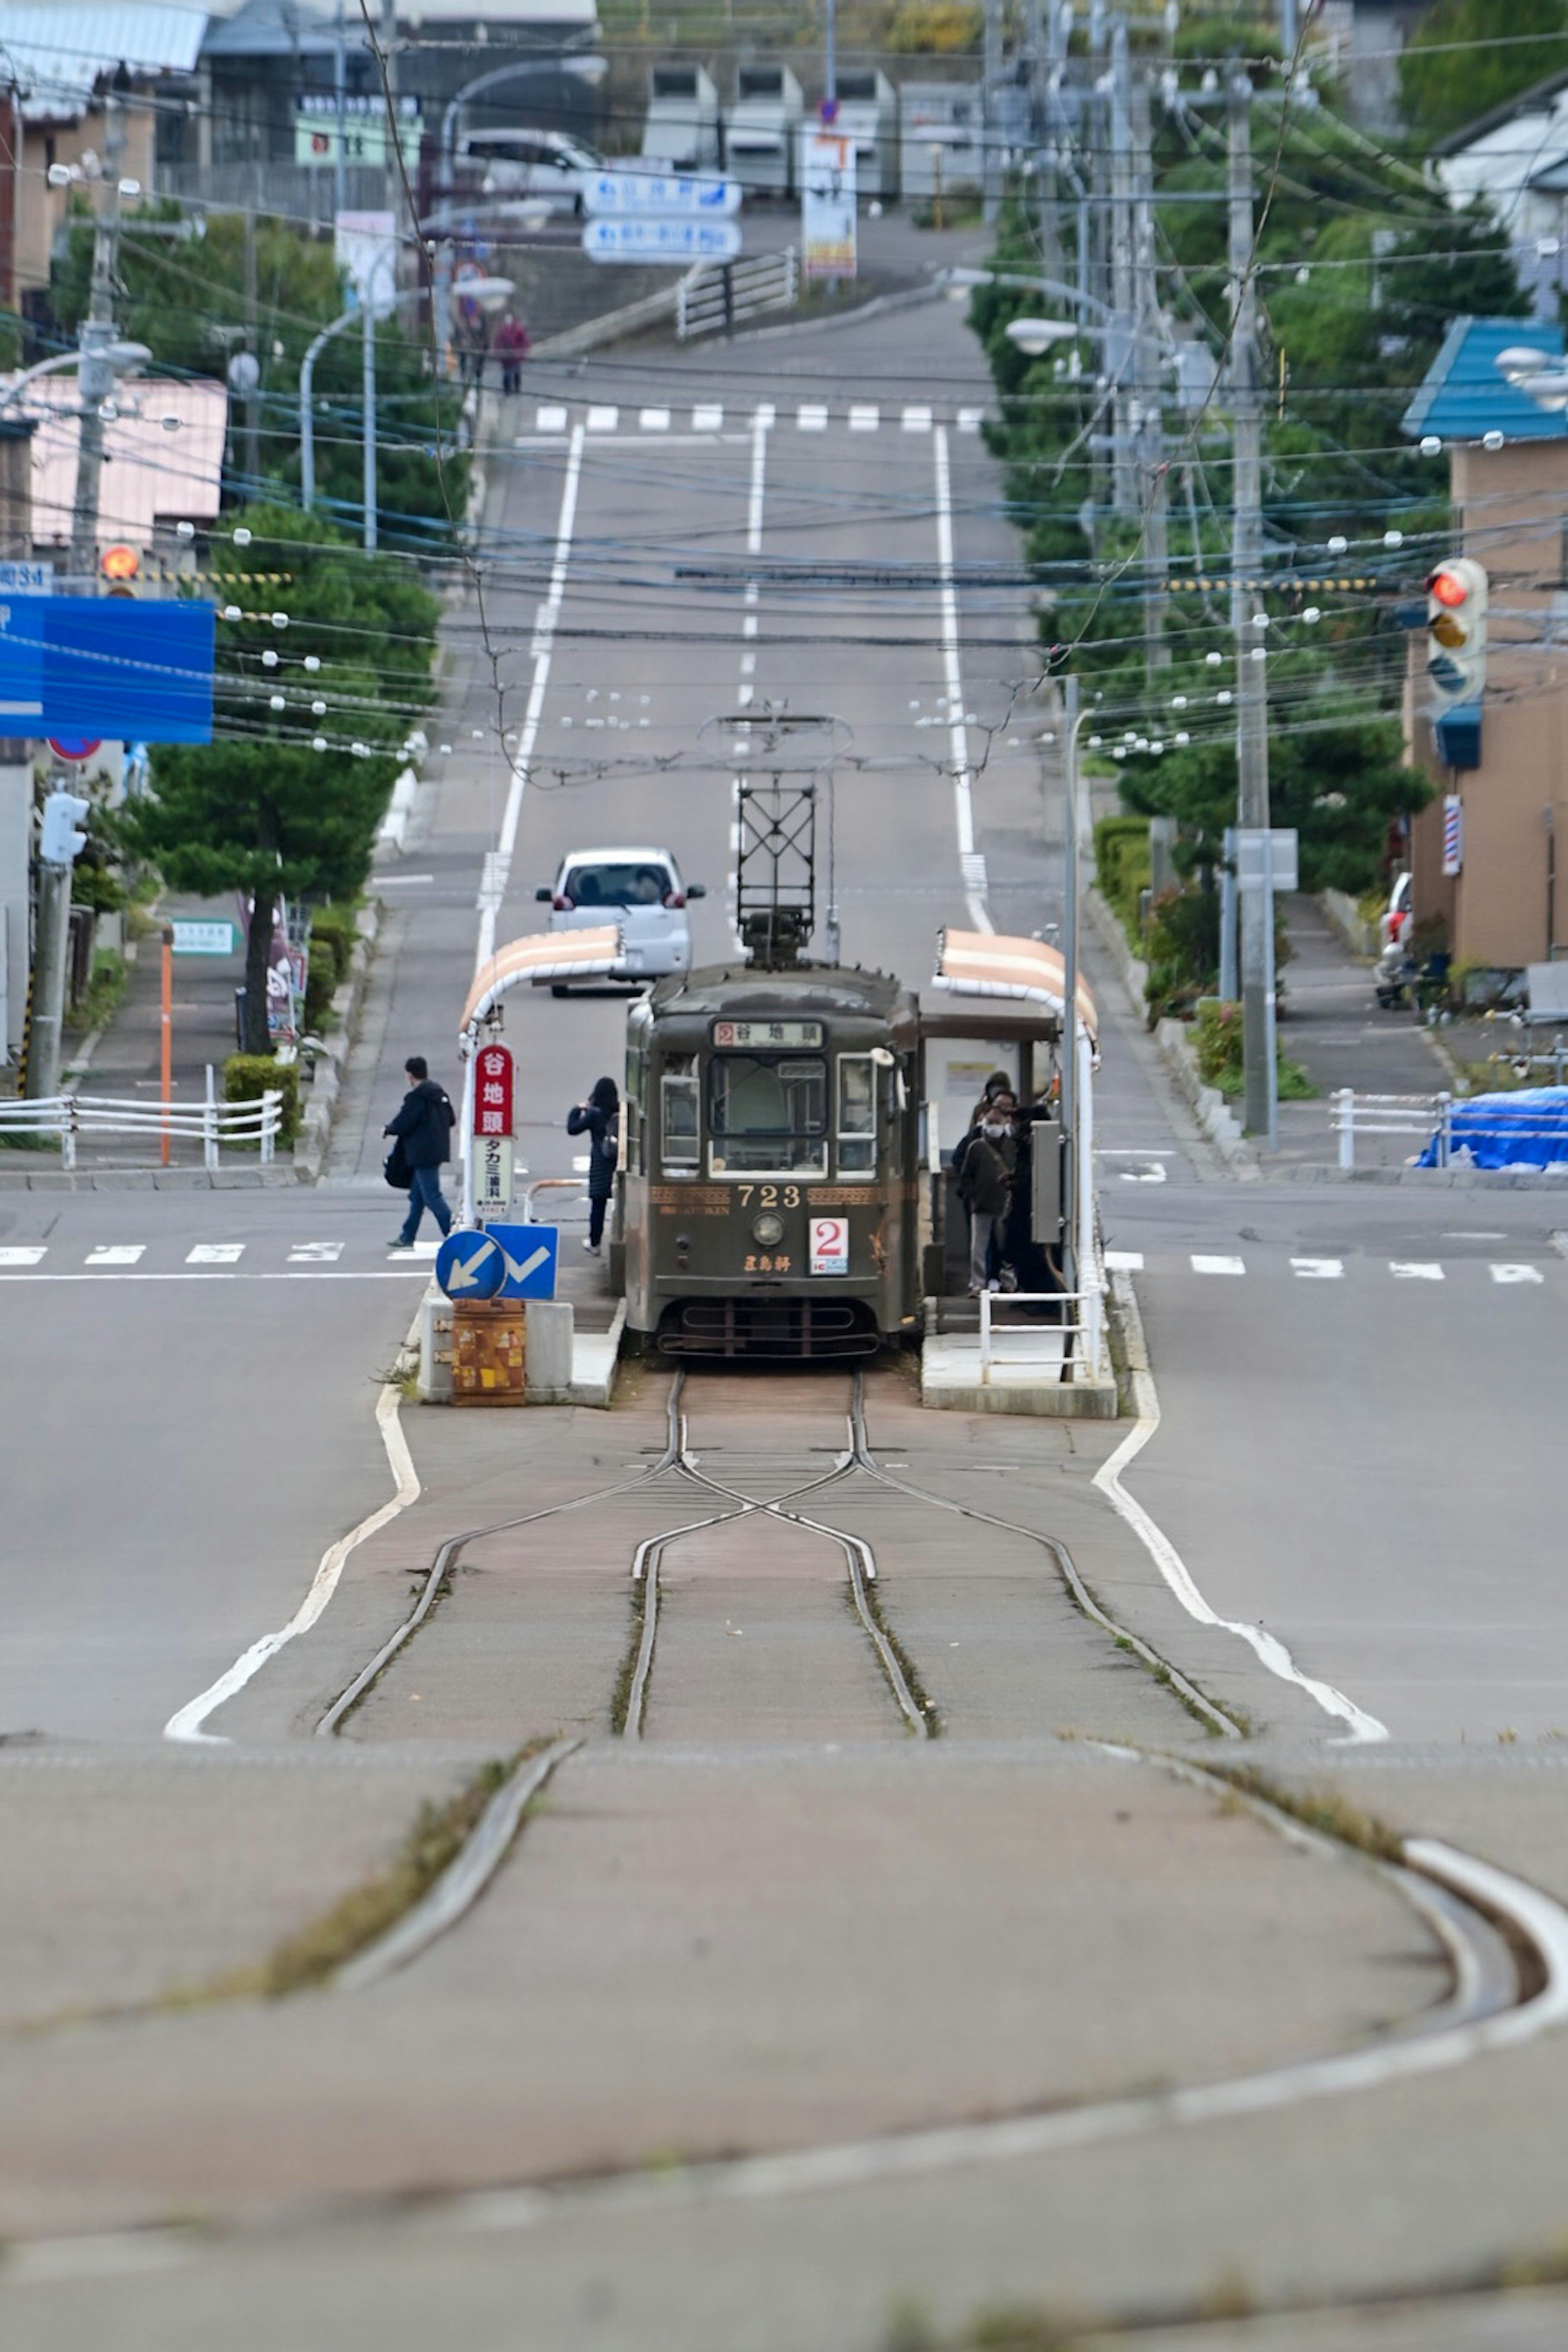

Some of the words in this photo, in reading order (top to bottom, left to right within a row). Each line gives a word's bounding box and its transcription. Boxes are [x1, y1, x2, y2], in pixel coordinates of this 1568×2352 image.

[720, 1024, 733, 1041] 2
[483, 1053, 505, 1133] 谷地頭
[737, 1185, 801, 1208] 723
[816, 1221, 841, 1256] 2
